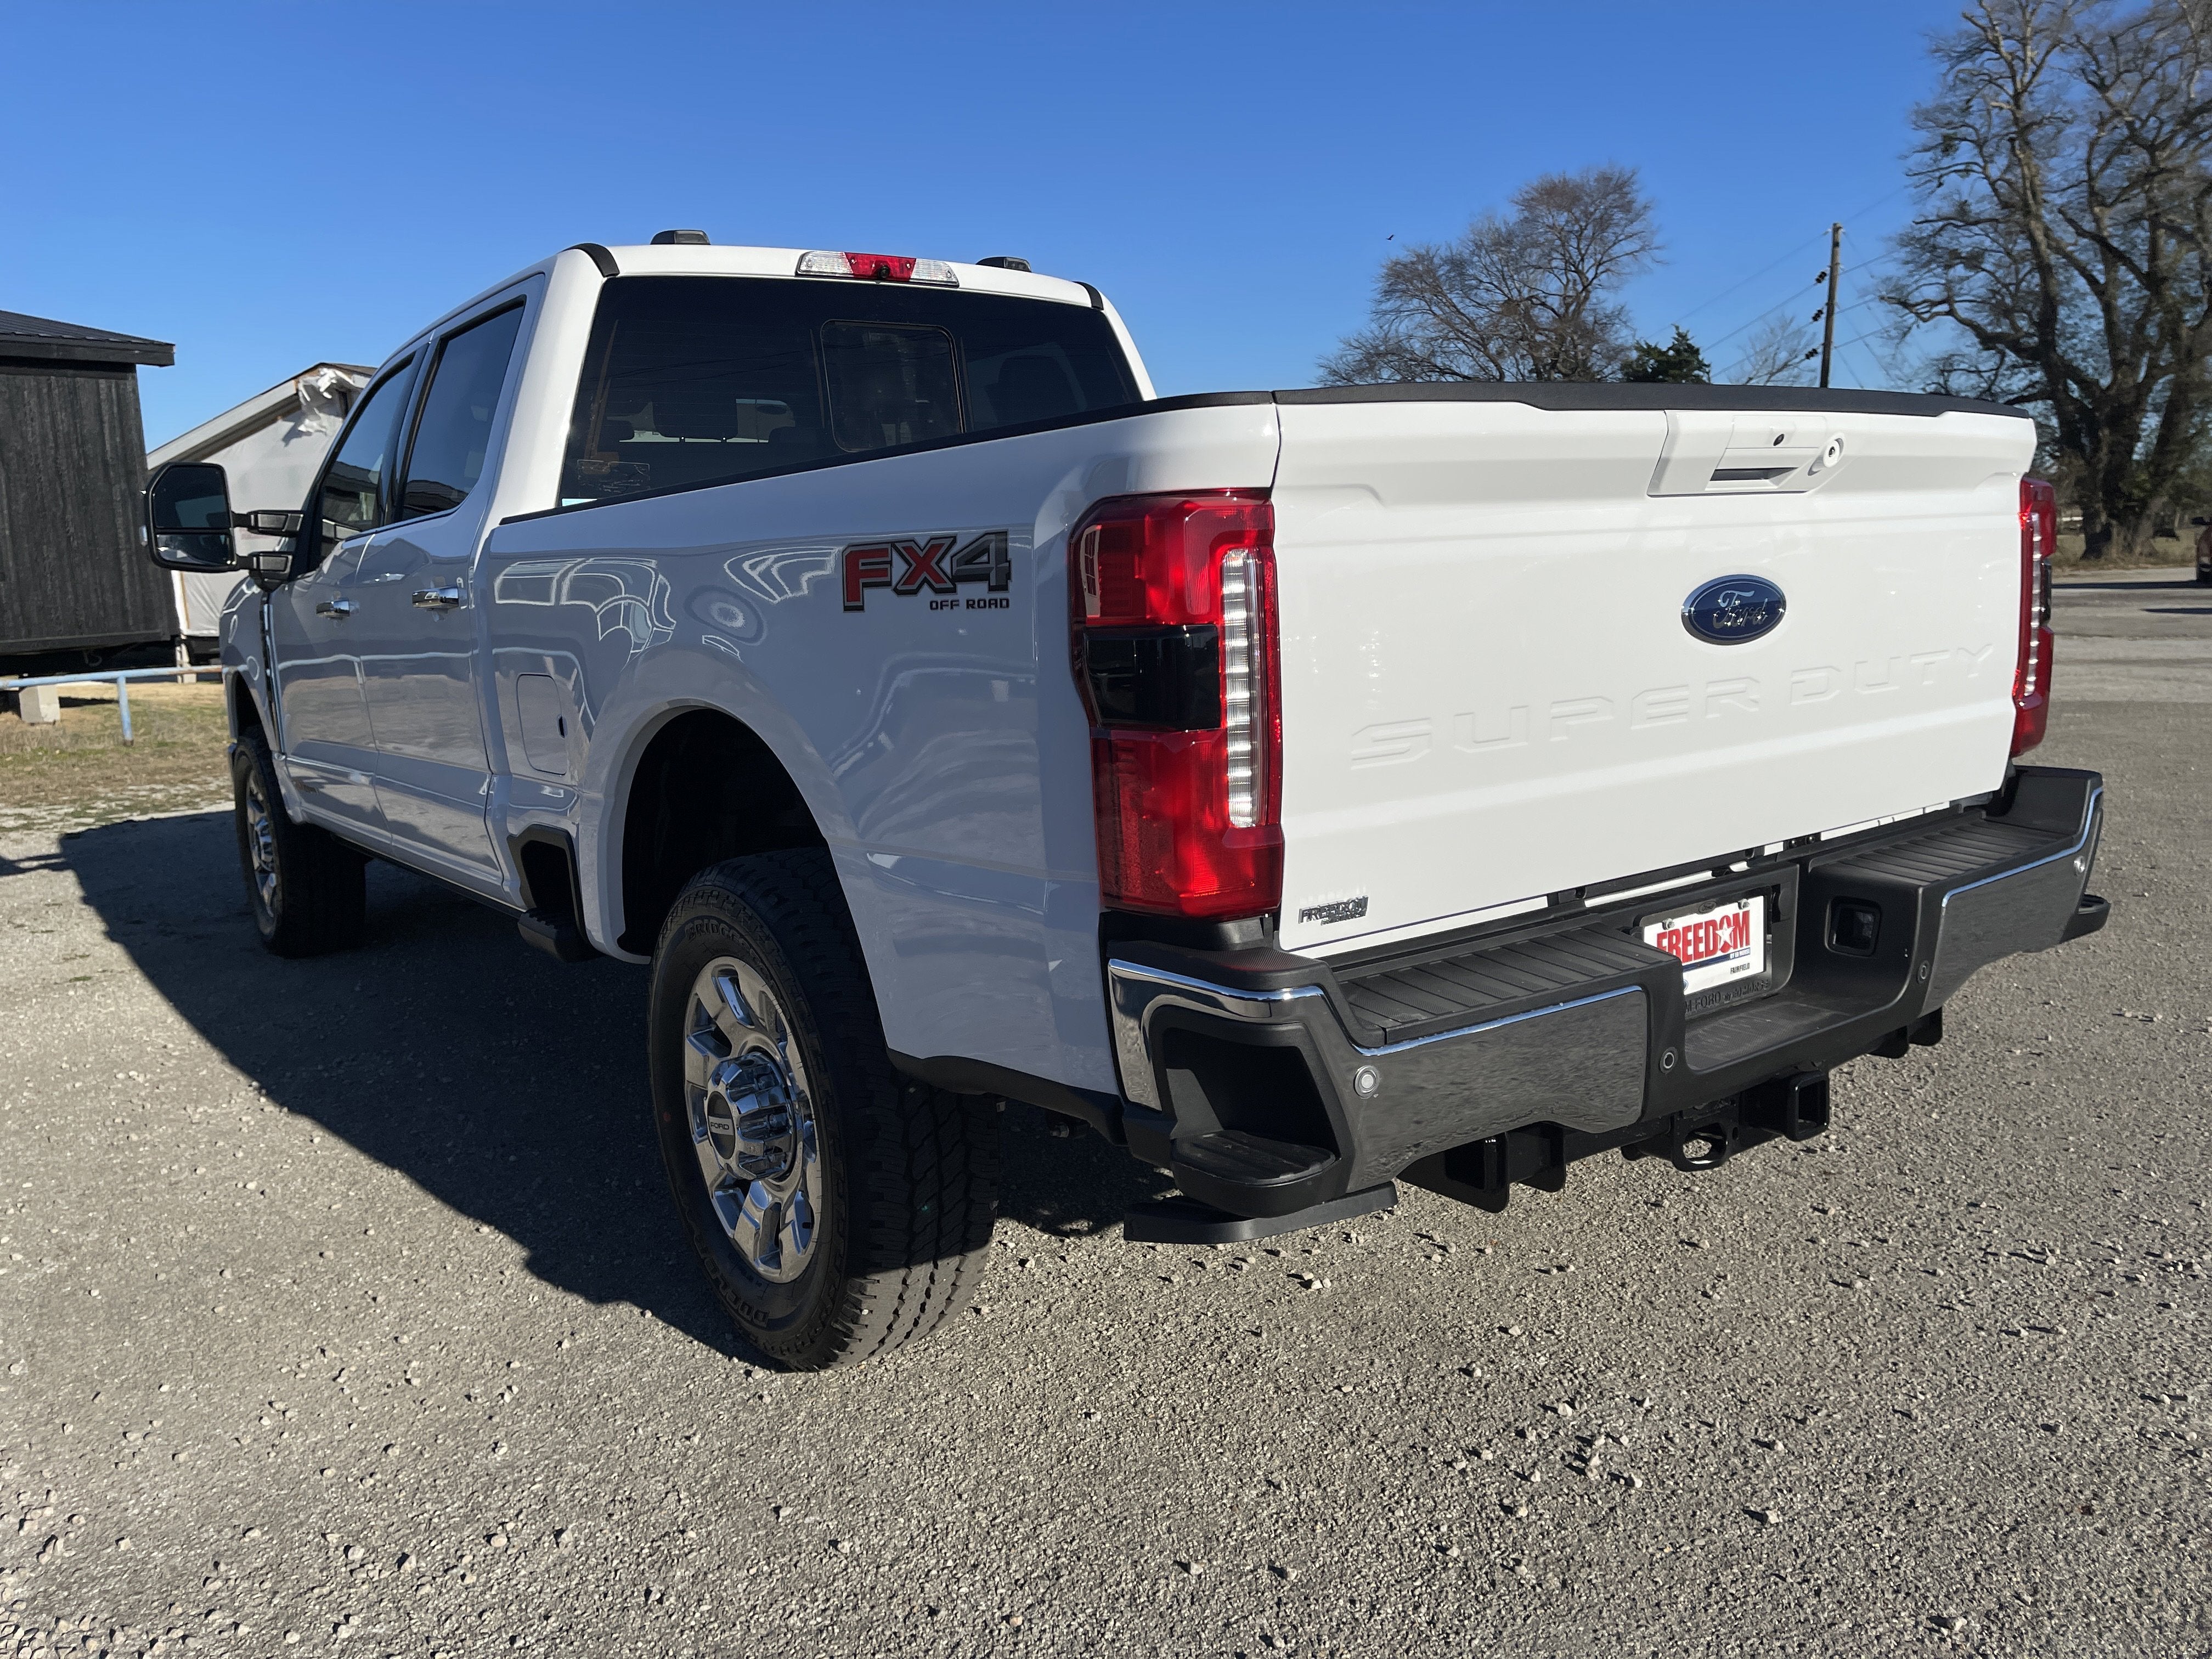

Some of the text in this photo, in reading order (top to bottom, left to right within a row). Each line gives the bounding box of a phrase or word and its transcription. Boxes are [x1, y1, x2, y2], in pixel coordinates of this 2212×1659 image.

[842, 529, 1012, 613] FX4
[929, 597, 1009, 611] OFF ROAD
[1713, 590, 1768, 629] Ford
[1351, 644, 1993, 770] SUPER DUTY
[1657, 910, 1751, 964] FREEDOM
[1730, 963, 1750, 974] FAIRFIELD
[1695, 991, 1722, 1011] FORD
[710, 1121, 730, 1130] FORD
